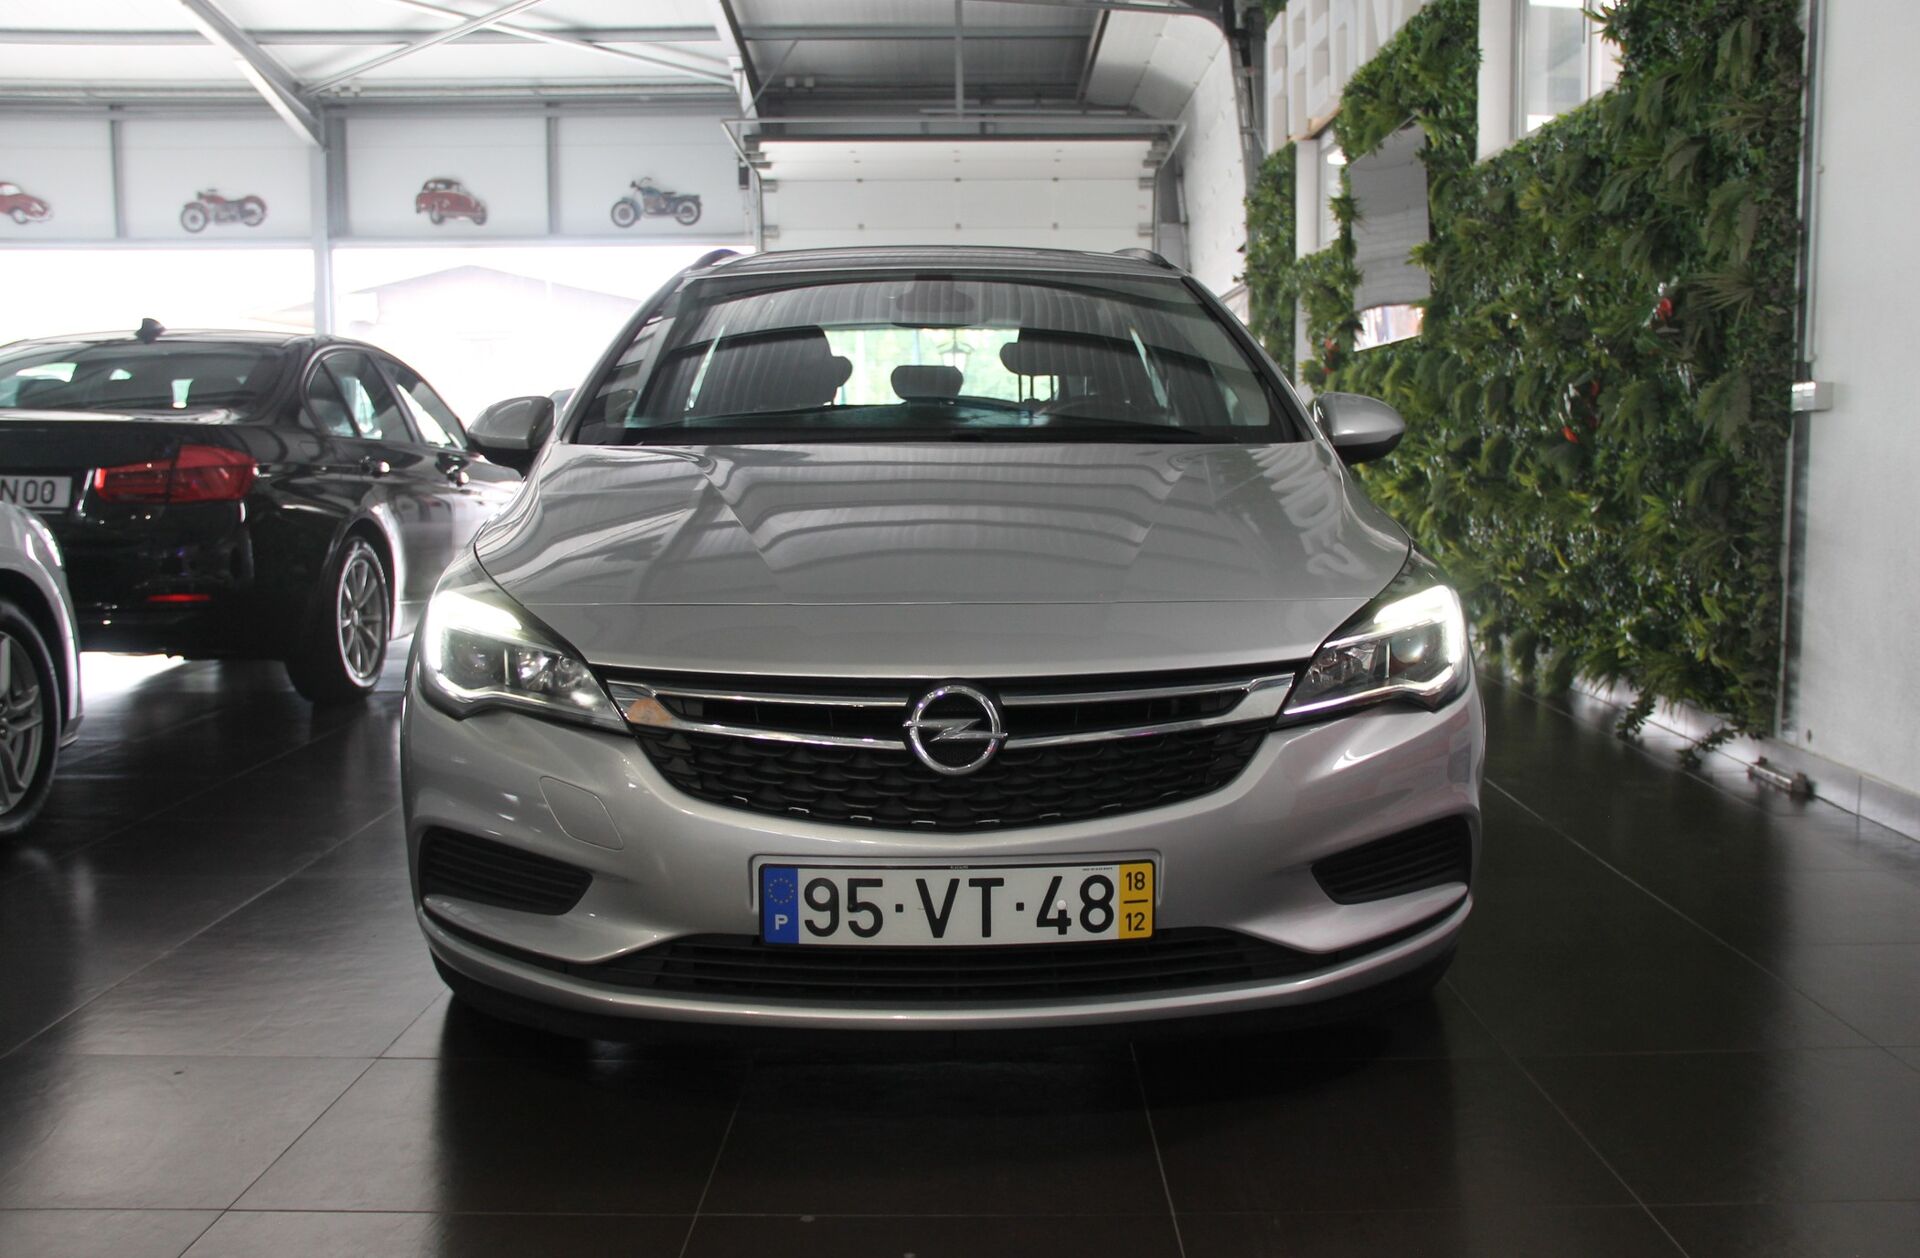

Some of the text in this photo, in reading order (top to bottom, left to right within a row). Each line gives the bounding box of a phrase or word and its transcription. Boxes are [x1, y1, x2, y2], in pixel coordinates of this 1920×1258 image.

[1126, 871, 1145, 891] 18
[775, 914, 788, 930] P
[1126, 911, 1145, 931] 12
